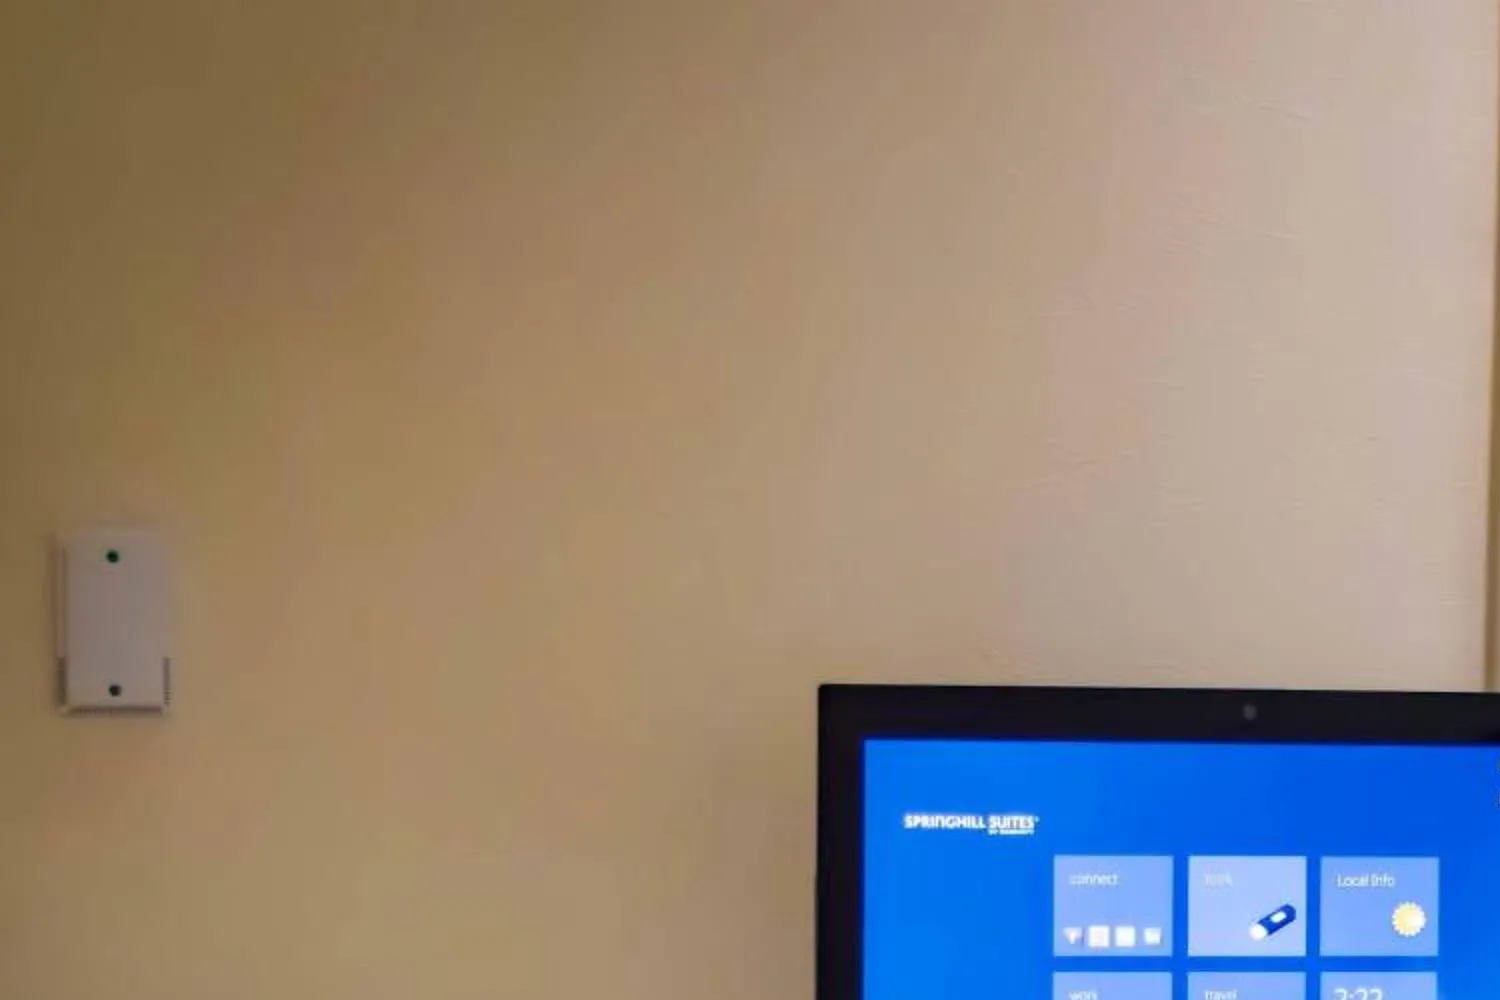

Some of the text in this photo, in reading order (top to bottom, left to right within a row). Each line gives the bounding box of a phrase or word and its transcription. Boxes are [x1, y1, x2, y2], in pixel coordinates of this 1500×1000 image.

[904, 814, 986, 829] SPRINGHILL
[1069, 873, 1119, 886] connect
[1337, 873, 1396, 887] Local Info
